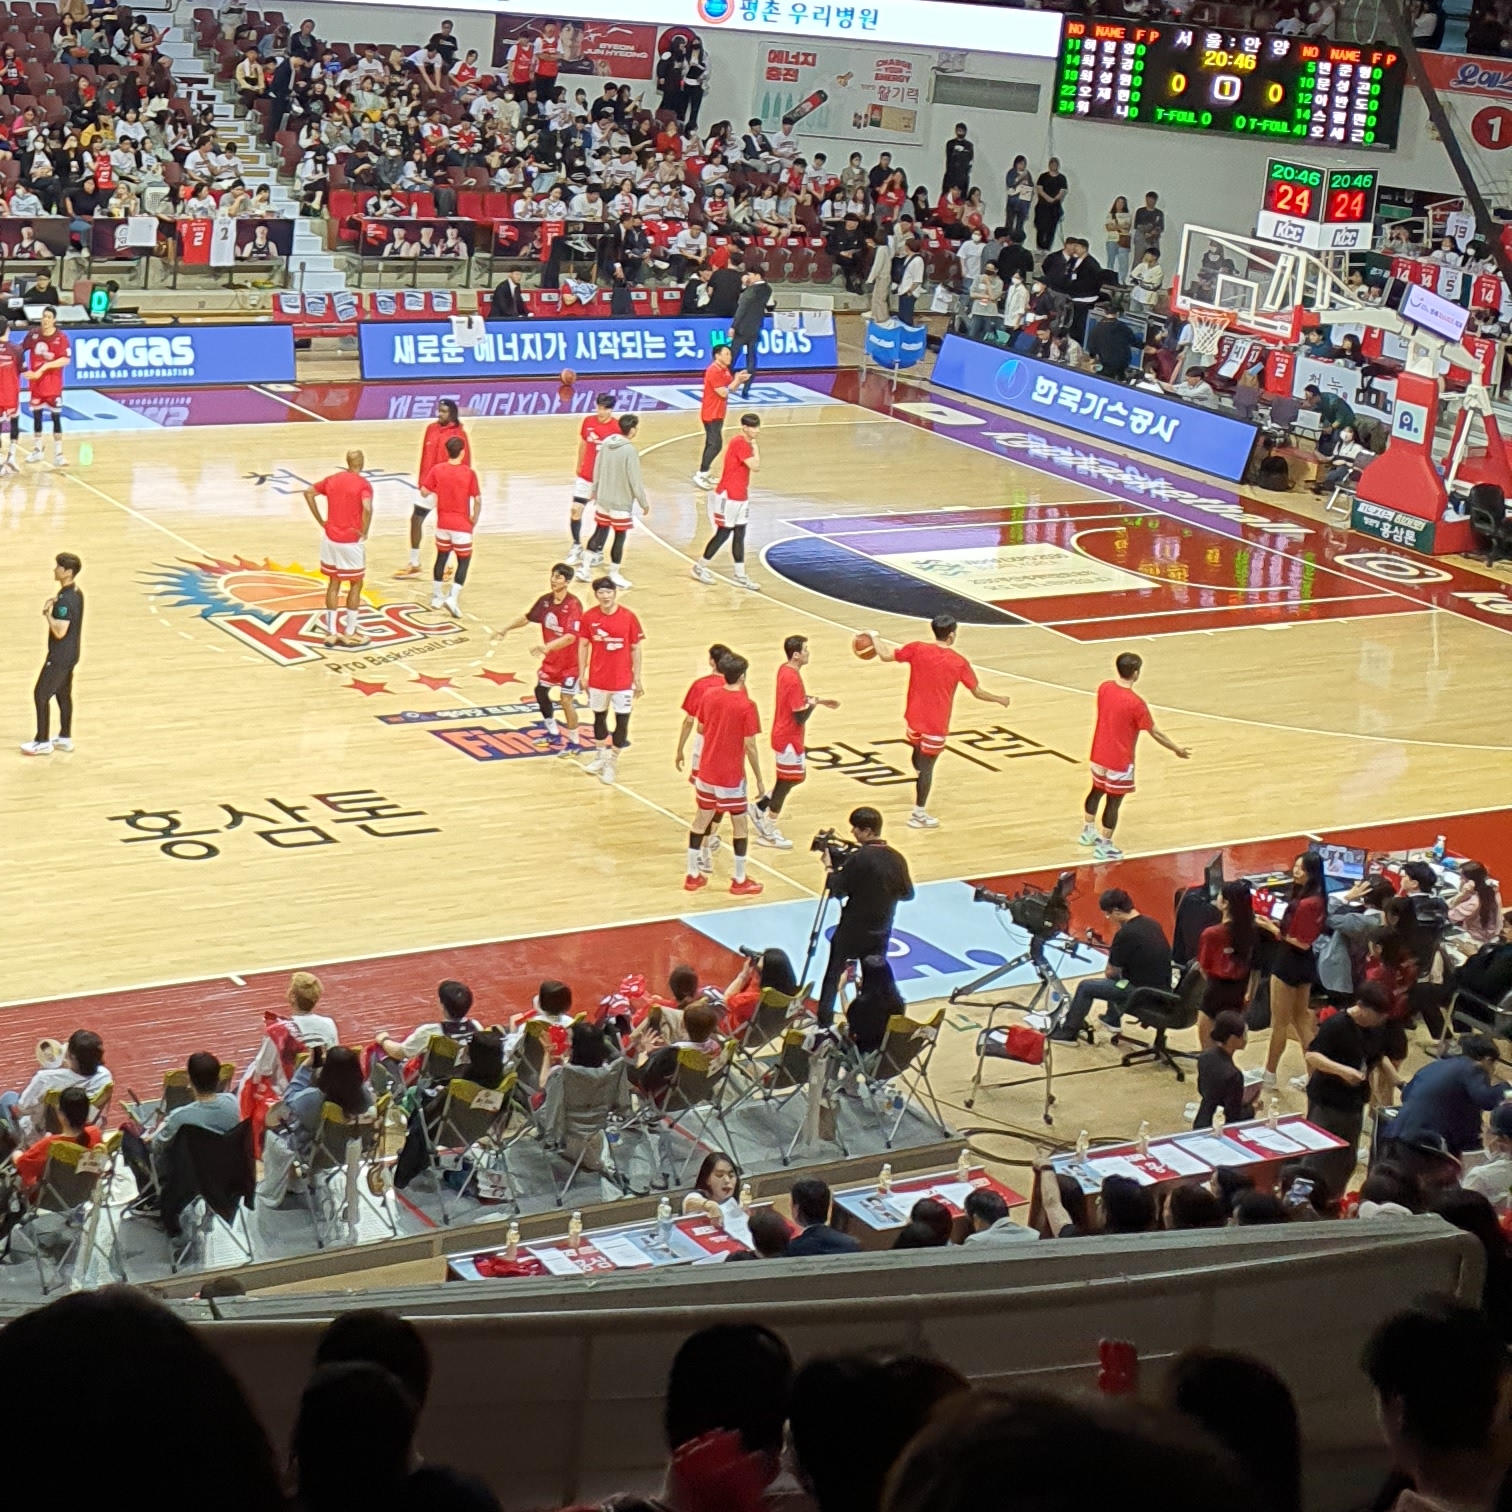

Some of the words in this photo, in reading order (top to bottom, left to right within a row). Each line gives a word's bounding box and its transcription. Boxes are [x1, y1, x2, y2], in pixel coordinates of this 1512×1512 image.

[788, 2, 879, 31] 우리병원
[1068, 23, 1085, 35] NO
[1095, 26, 1127, 39] NAME
[1136, 29, 1146, 41] F
[1149, 31, 1160, 42] P
[1069, 38, 1081, 50] 11
[1136, 44, 1147, 56] 0
[1302, 46, 1319, 58] NO
[1330, 49, 1361, 62] NAME
[1372, 52, 1382, 64] F
[1386, 54, 1397, 66] P
[767, 49, 817, 67] 에너지
[1066, 55, 1080, 66] 14
[1134, 60, 1144, 71] 0
[1204, 50, 1257, 70] 20:46
[766, 66, 799, 82] 충전
[1307, 61, 1316, 73] 5
[1372, 68, 1383, 79] 0
[1132, 75, 1143, 87] 0
[1171, 74, 1186, 93] 0
[1268, 84, 1283, 102] 0
[1300, 77, 1315, 88] 10
[1370, 84, 1380, 95] 0
[1061, 84, 1077, 96] 22
[1131, 91, 1141, 102] 0
[1298, 93, 1312, 104] 12
[1369, 99, 1379, 111] 0
[1129, 106, 1139, 118] 0
[1156, 108, 1198, 123] T-FOUL
[1201, 112, 1212, 125] 0
[1235, 115, 1246, 128] 0
[1249, 118, 1291, 133] T-FOUL
[1296, 108, 1311, 120] 14
[1367, 115, 1377, 127] 0
[1292, 124, 1307, 135] 41
[1364, 131, 1375, 143] 0
[1488, 116, 1502, 142] 1
[1271, 164, 1321, 186] 20:46
[1330, 174, 1374, 188] 20:46
[1276, 184, 1310, 214] 24
[1334, 192, 1365, 218] 24
[1275, 222, 1304, 242] KCC
[1333, 229, 1359, 246] KCC
[75, 335, 195, 370] KOGAS
[393, 334, 465, 364] 새로운
[473, 331, 568, 363] 에너지가
[575, 330, 667, 360] 시작되는
[1031, 375, 1180, 444] 한국가스공사
[1379, 521, 1417, 548] 홍삼톤
[203, 601, 467, 667] KGC
[326, 653, 366, 675] Pro
[369, 641, 443, 667] Basketball
[107, 788, 443, 861] 홍삼톤
